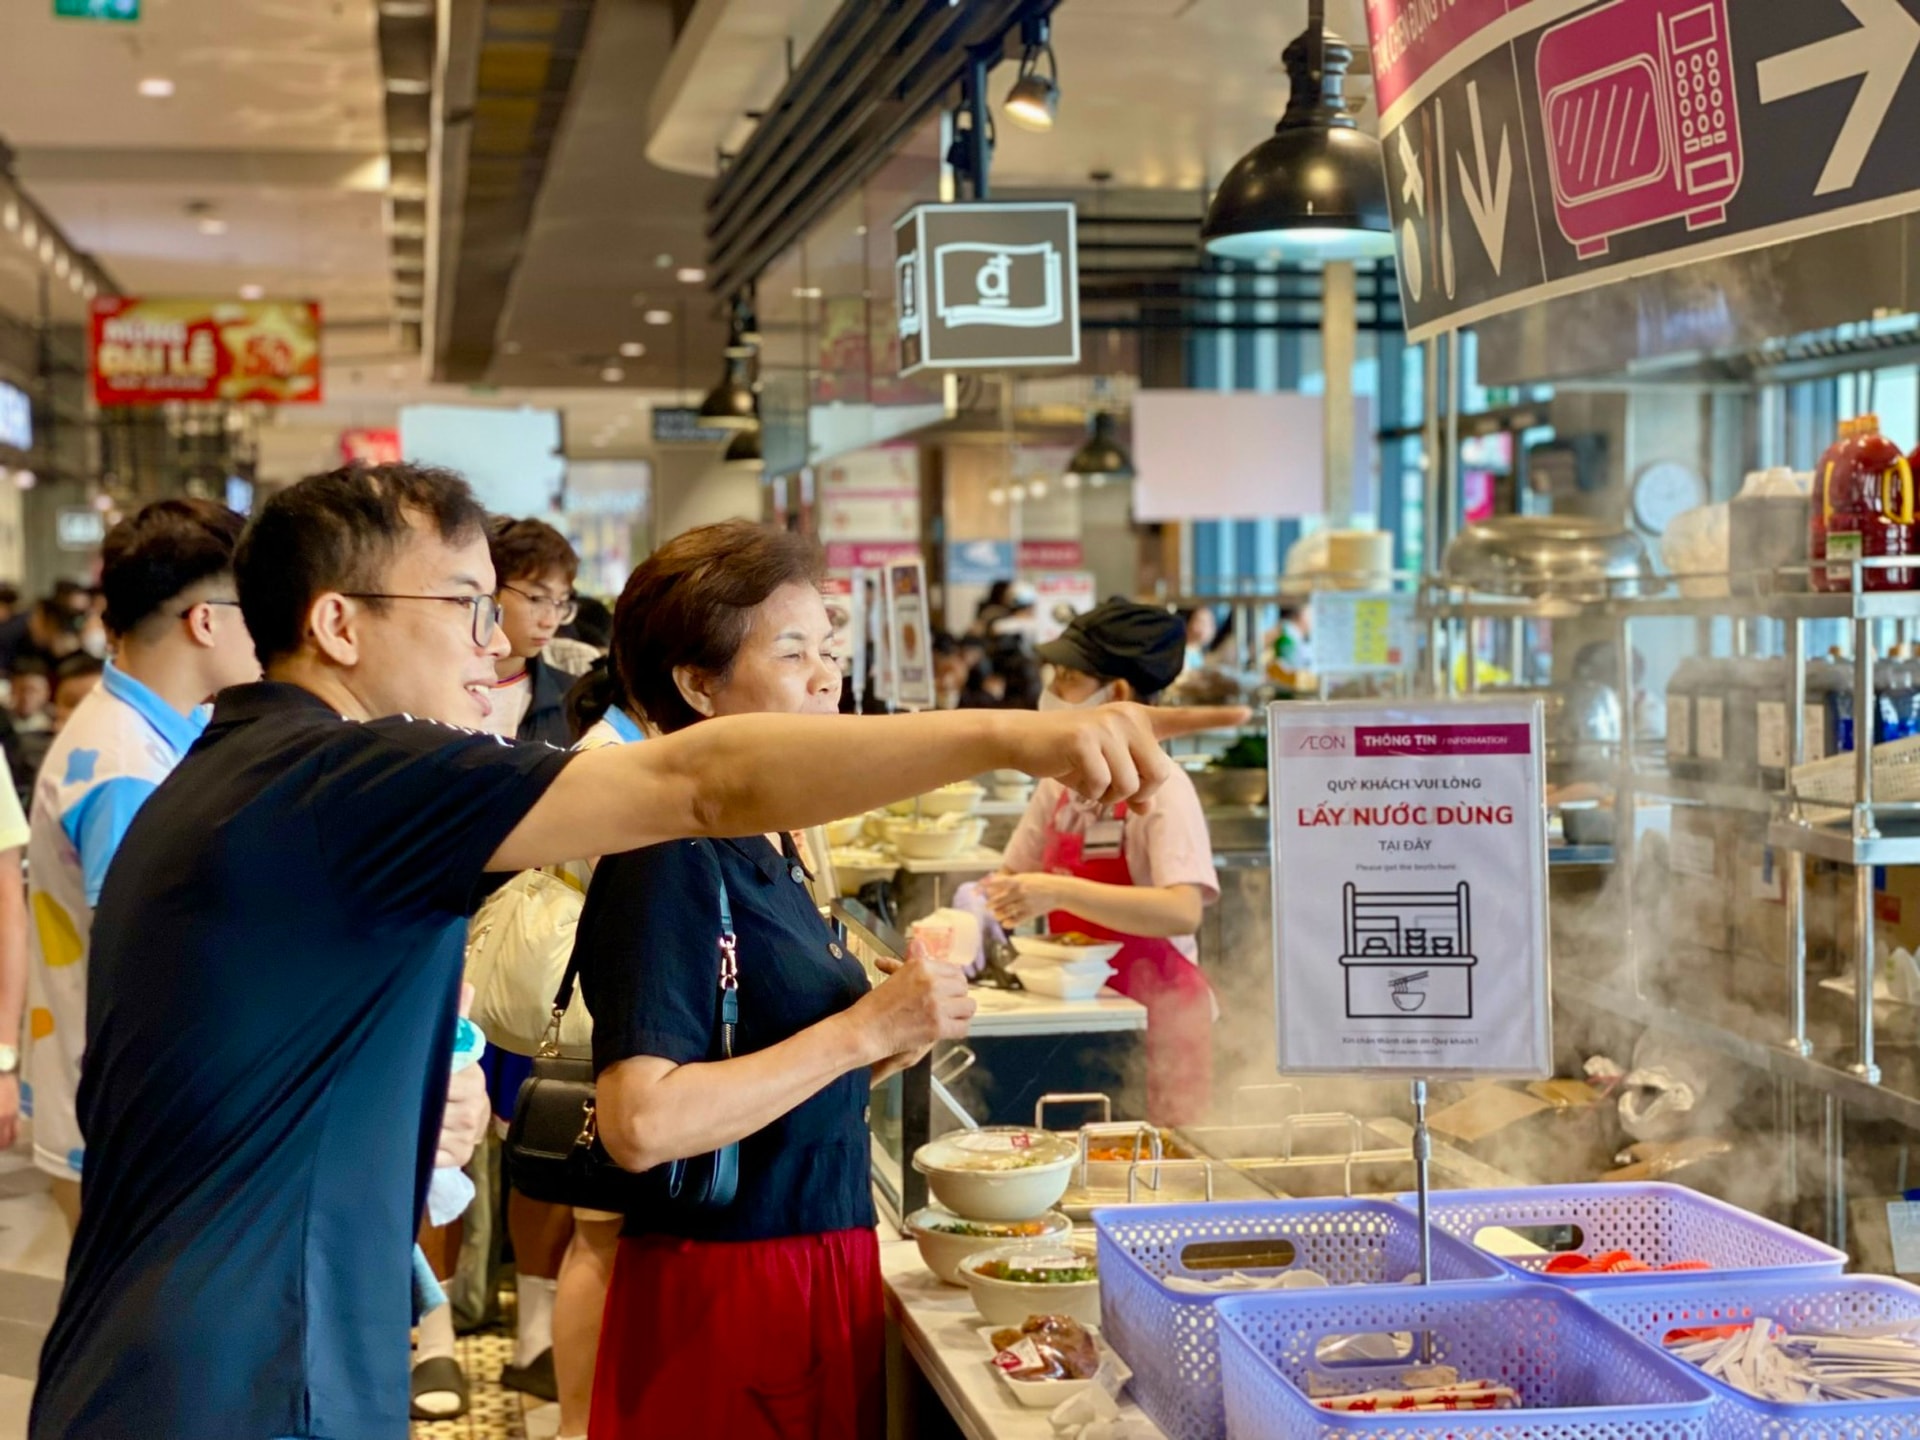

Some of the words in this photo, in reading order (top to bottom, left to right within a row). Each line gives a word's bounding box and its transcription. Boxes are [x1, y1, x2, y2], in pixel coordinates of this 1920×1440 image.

[1363, 733, 1411, 747] THÔNG
[1414, 734, 1437, 746] TIN
[1360, 777, 1409, 790] KHÁCH
[1414, 778, 1438, 789] VUI
[1442, 775, 1482, 789] LÒNG
[1298, 800, 1345, 826] LẤY
[1353, 801, 1427, 826] NƯỚC
[1436, 801, 1513, 824] DÙNG
[1378, 840, 1400, 854] TẠI
[1403, 837, 1432, 851] ĐÂY
